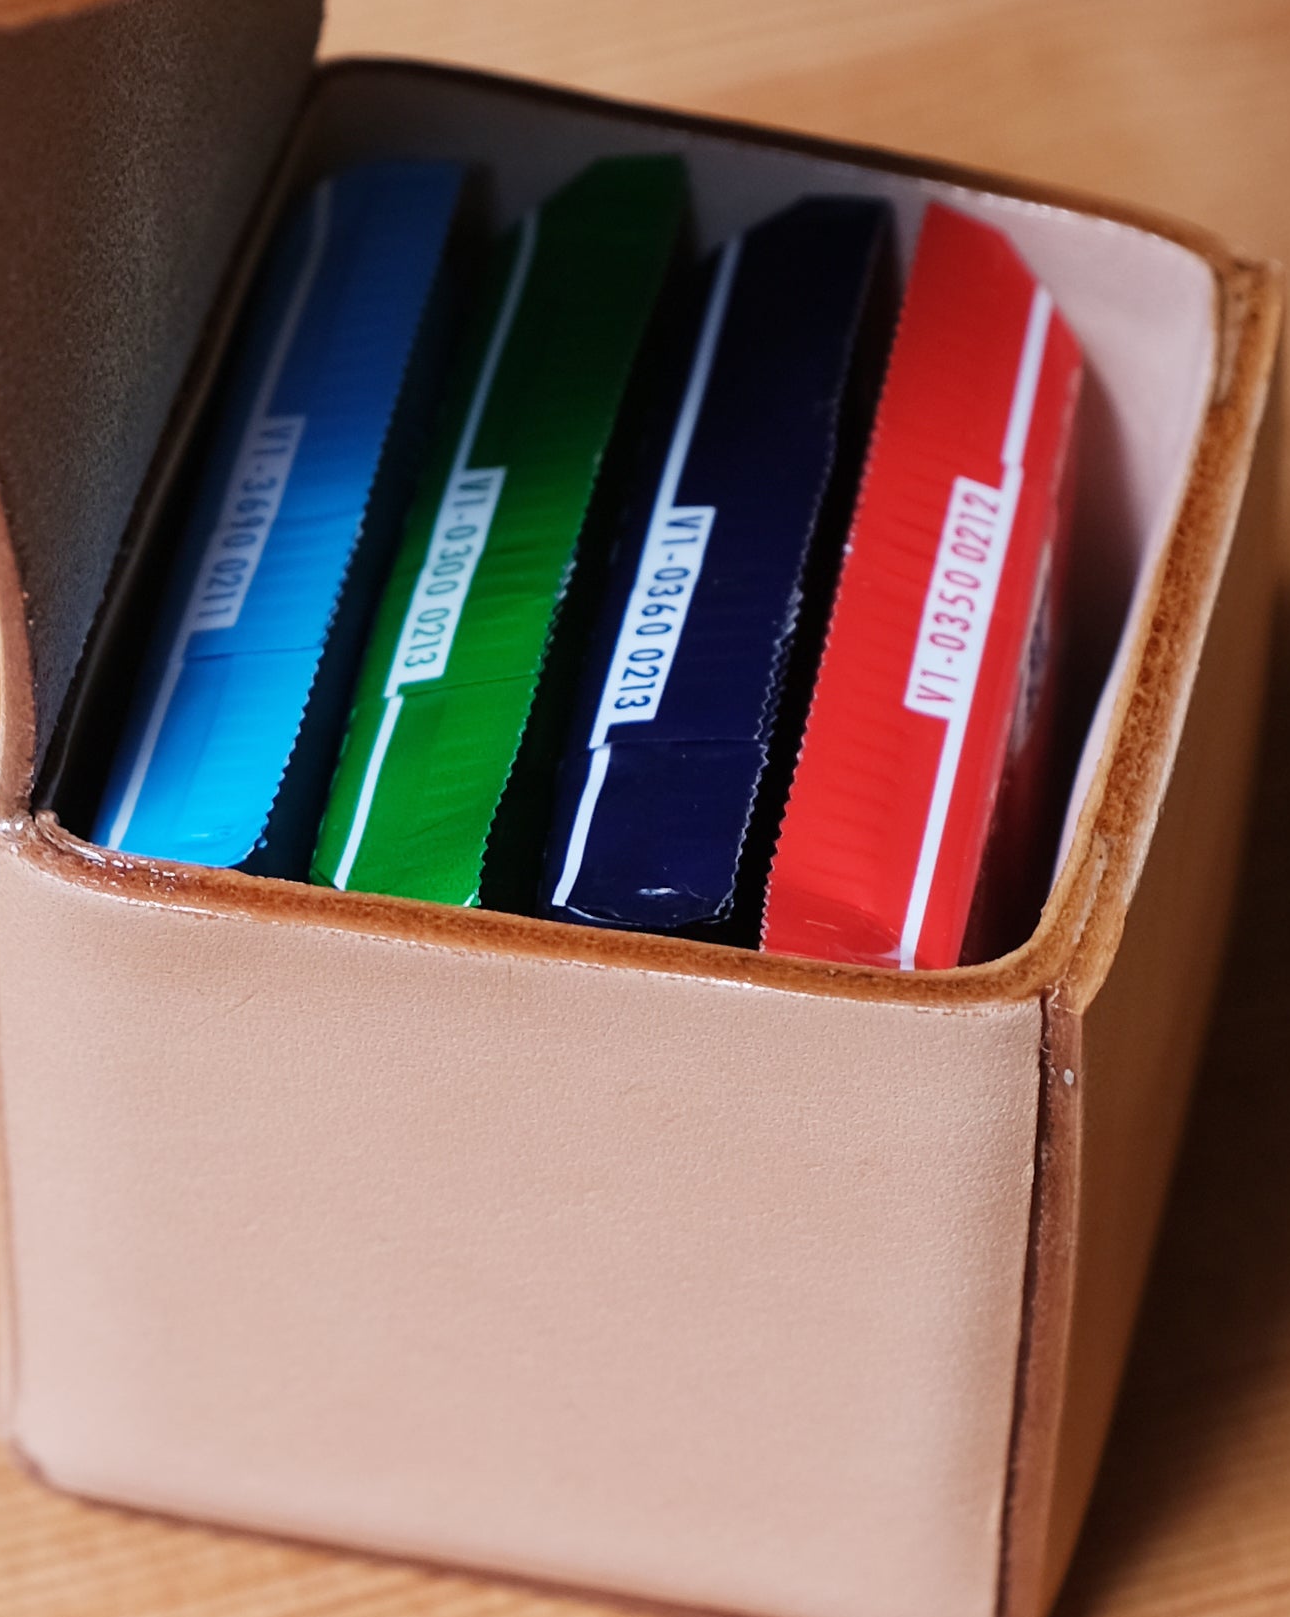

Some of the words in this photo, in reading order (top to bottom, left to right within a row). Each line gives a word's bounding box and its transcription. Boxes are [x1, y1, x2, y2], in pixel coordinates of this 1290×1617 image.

[424, 475, 494, 597] V1-0300
[634, 514, 704, 637] V1-0360
[198, 558, 249, 619] 0211
[915, 570, 981, 707] V1-0350
[951, 491, 1001, 565] 0212
[403, 606, 451, 670] 0213
[613, 645, 665, 711] 0213
